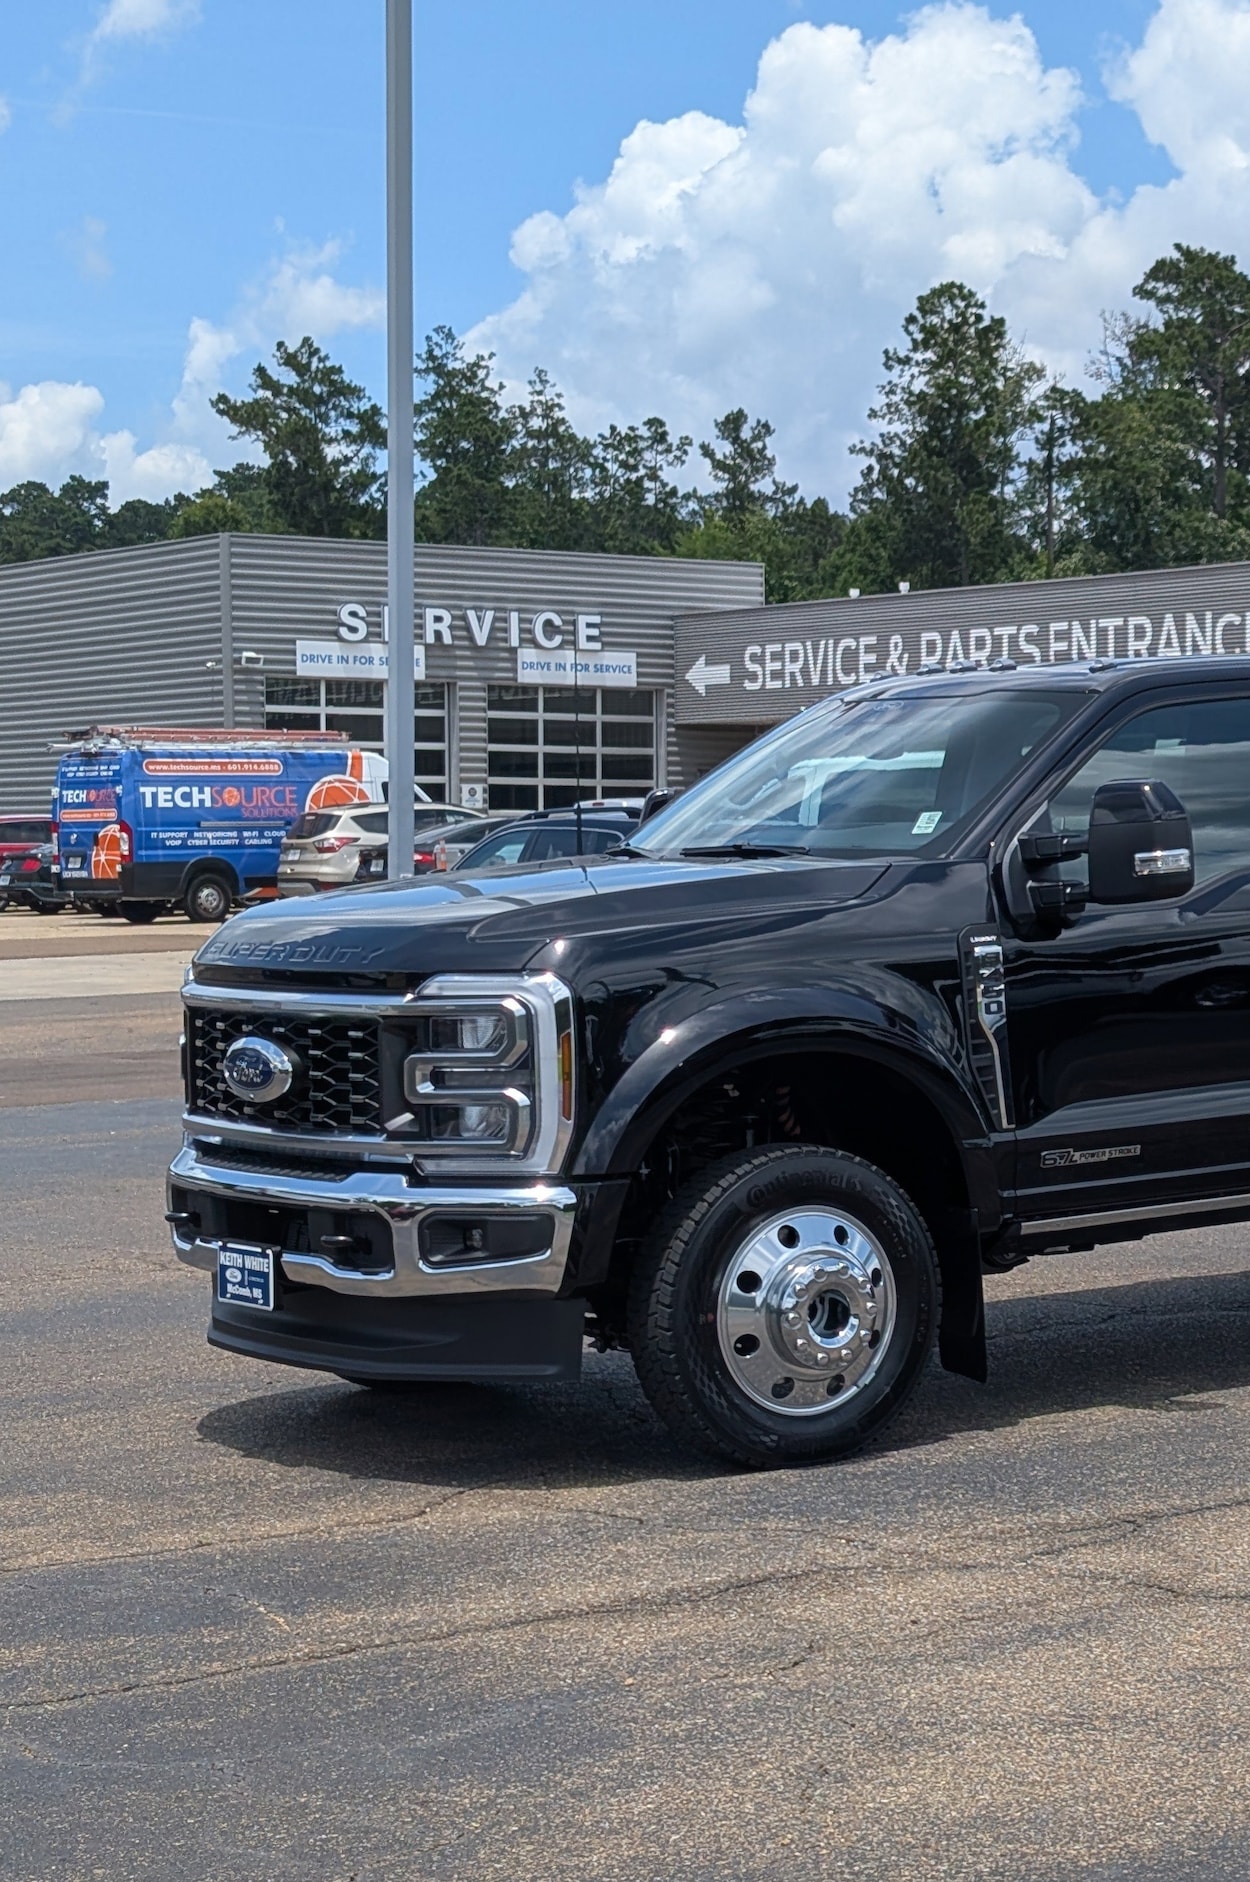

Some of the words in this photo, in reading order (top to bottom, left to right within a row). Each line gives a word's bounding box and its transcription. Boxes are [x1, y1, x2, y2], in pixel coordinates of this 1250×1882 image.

[338, 603, 602, 650] SRVICE
[301, 653, 333, 664] DRIVE
[337, 655, 349, 665] IN
[353, 656, 374, 667] FOR
[521, 661, 552, 671] DRIVE
[555, 662, 567, 672] IN
[570, 663, 590, 673] FOR
[593, 664, 632, 674] SERVICE
[743, 636, 878, 690] SERVICE
[886, 634, 909, 676] &
[241, 807, 298, 818] SOLUTIONS
[1041, 1149, 1079, 1167] 6.7L
[1080, 1150, 1106, 1160] POWER
[1108, 1147, 1139, 1157] STROKE
[220, 1251, 243, 1268] KEITH
[244, 1255, 270, 1272] WHITE
